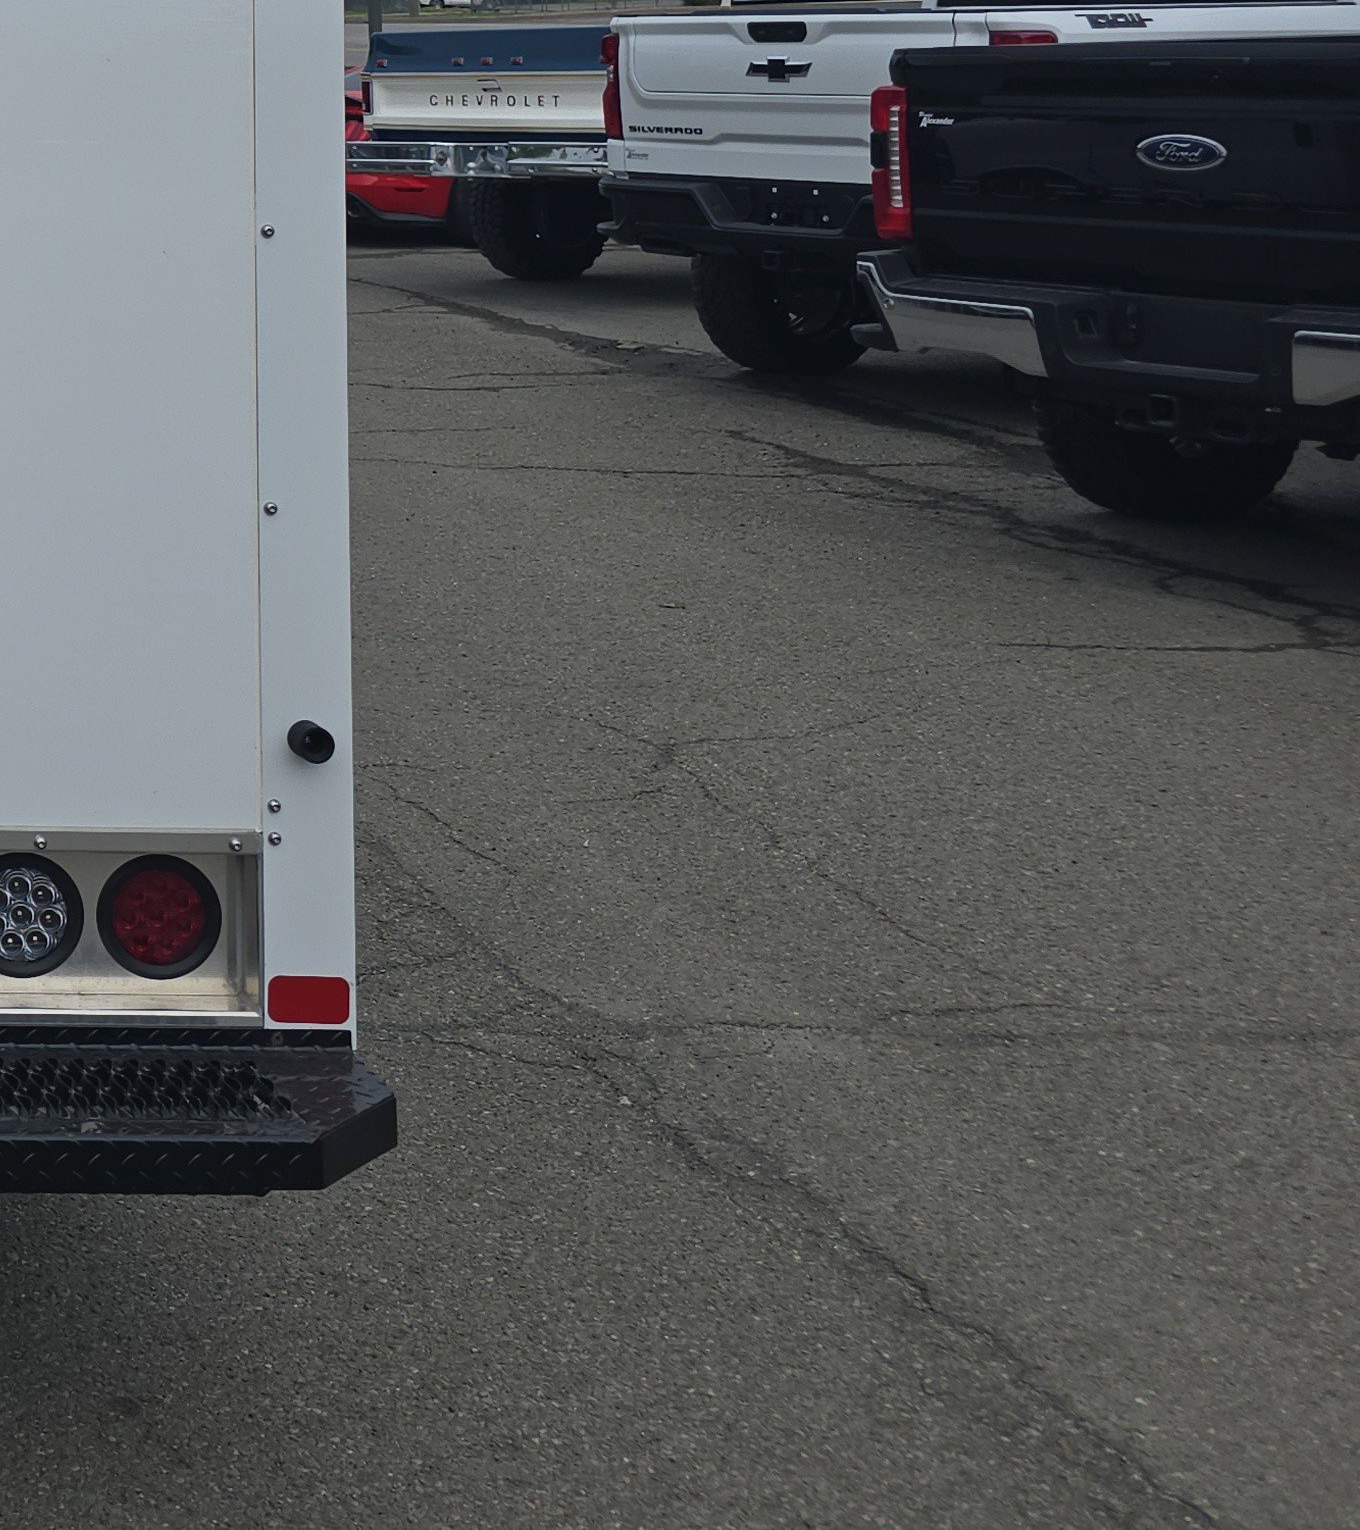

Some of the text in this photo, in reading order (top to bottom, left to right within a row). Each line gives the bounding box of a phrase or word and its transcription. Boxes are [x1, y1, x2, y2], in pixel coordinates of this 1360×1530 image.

[429, 94, 561, 107] CHEVROLET
[628, 125, 703, 136] SILVERADO
[1156, 141, 1203, 162] Ford
